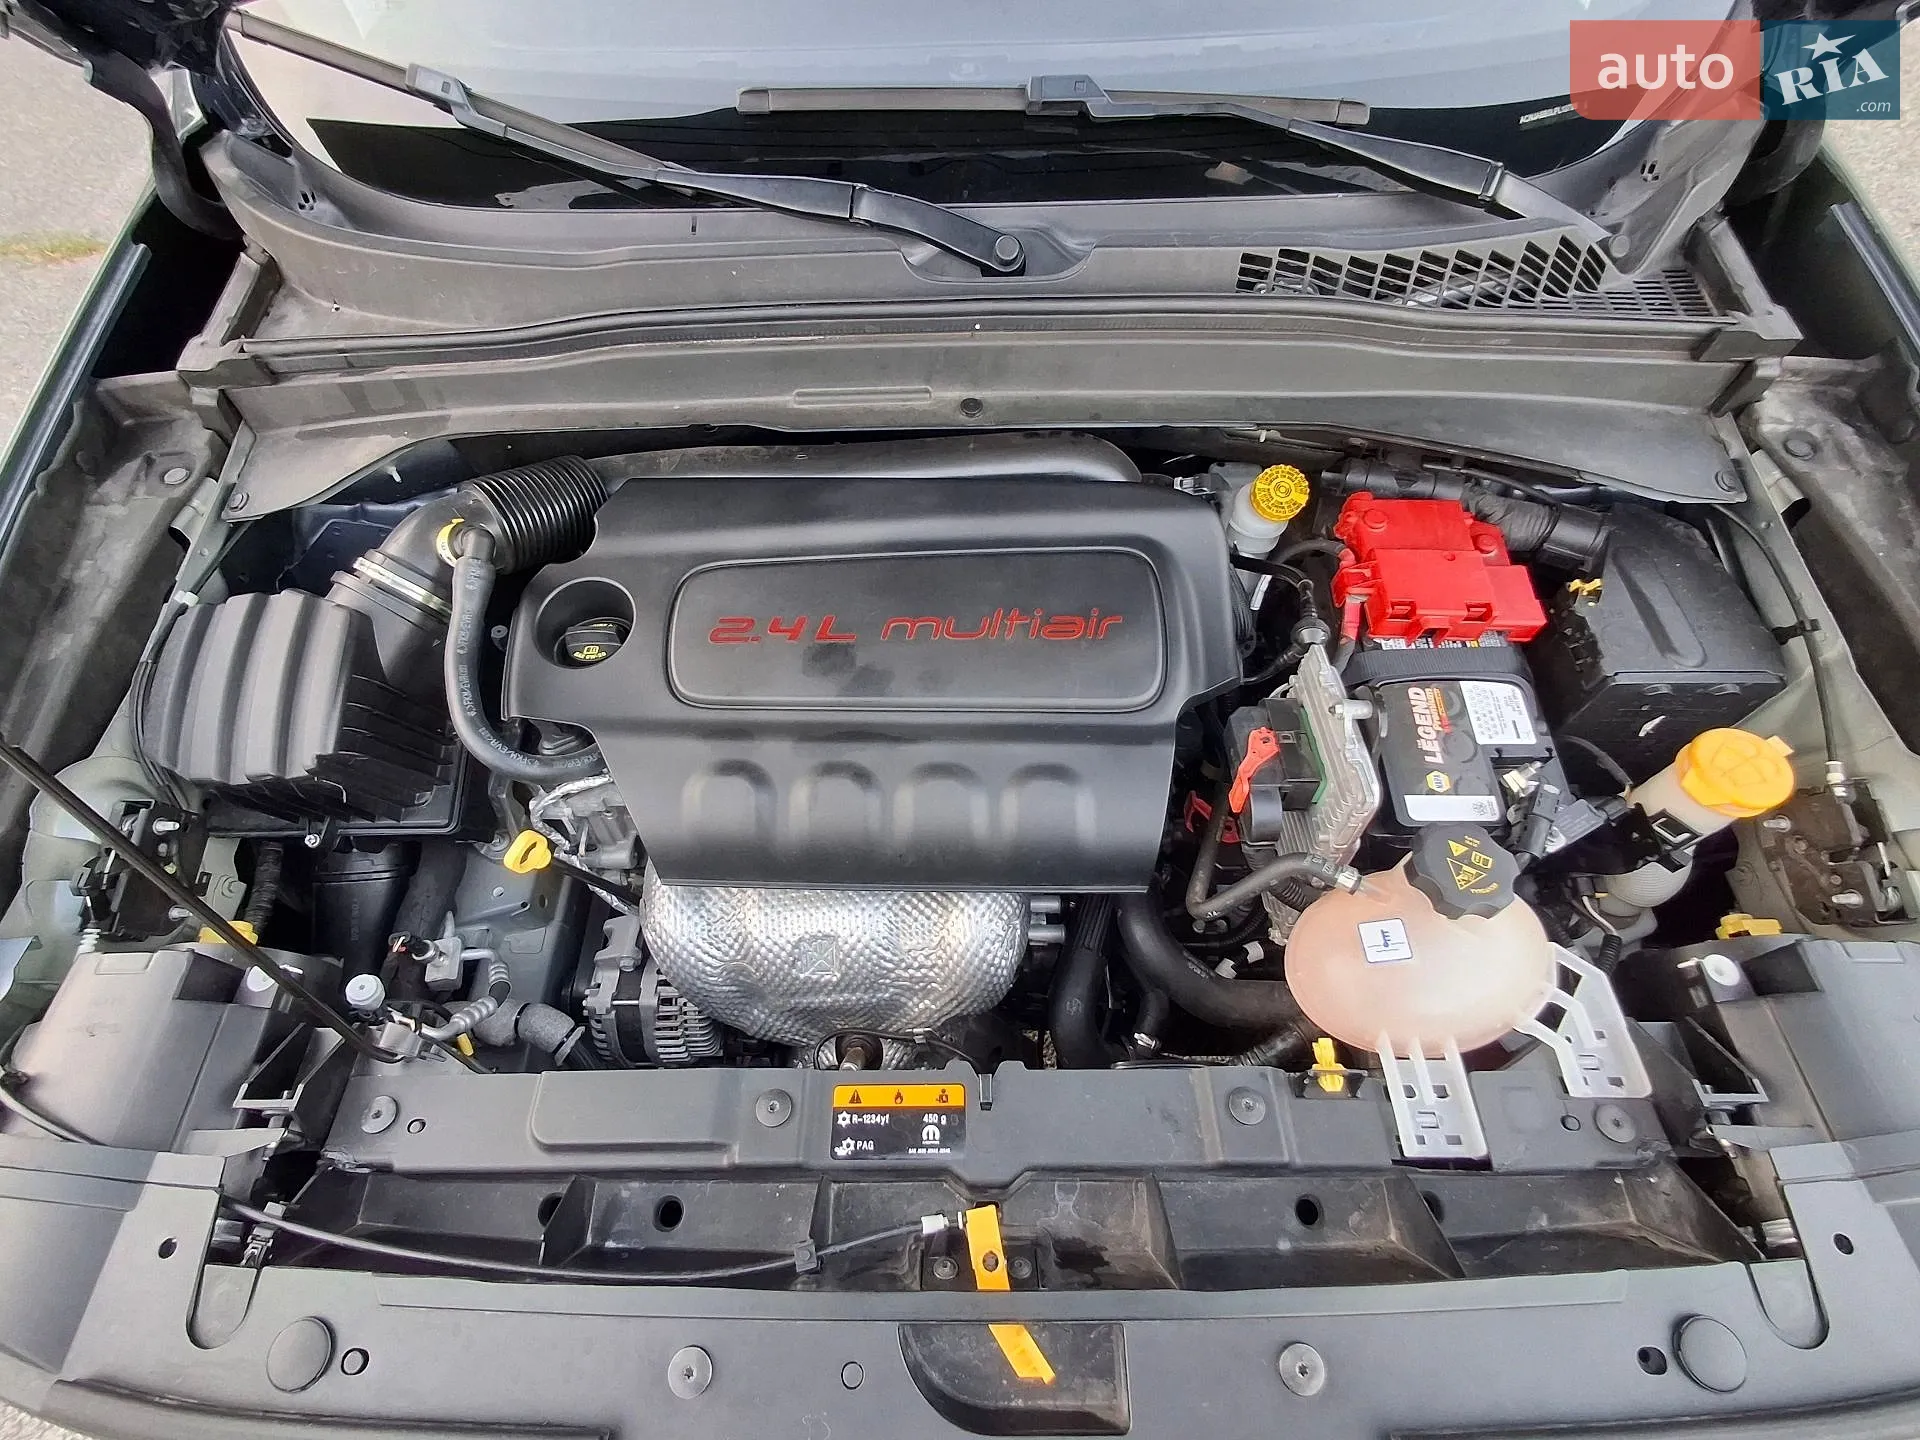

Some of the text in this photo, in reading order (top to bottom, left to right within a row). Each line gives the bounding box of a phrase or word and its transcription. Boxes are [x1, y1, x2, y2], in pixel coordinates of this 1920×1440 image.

[880, 607, 1123, 641] multiair
[852, 1113, 947, 1126] R-1234yf 450 g
[856, 1140, 874, 1151] PAG
